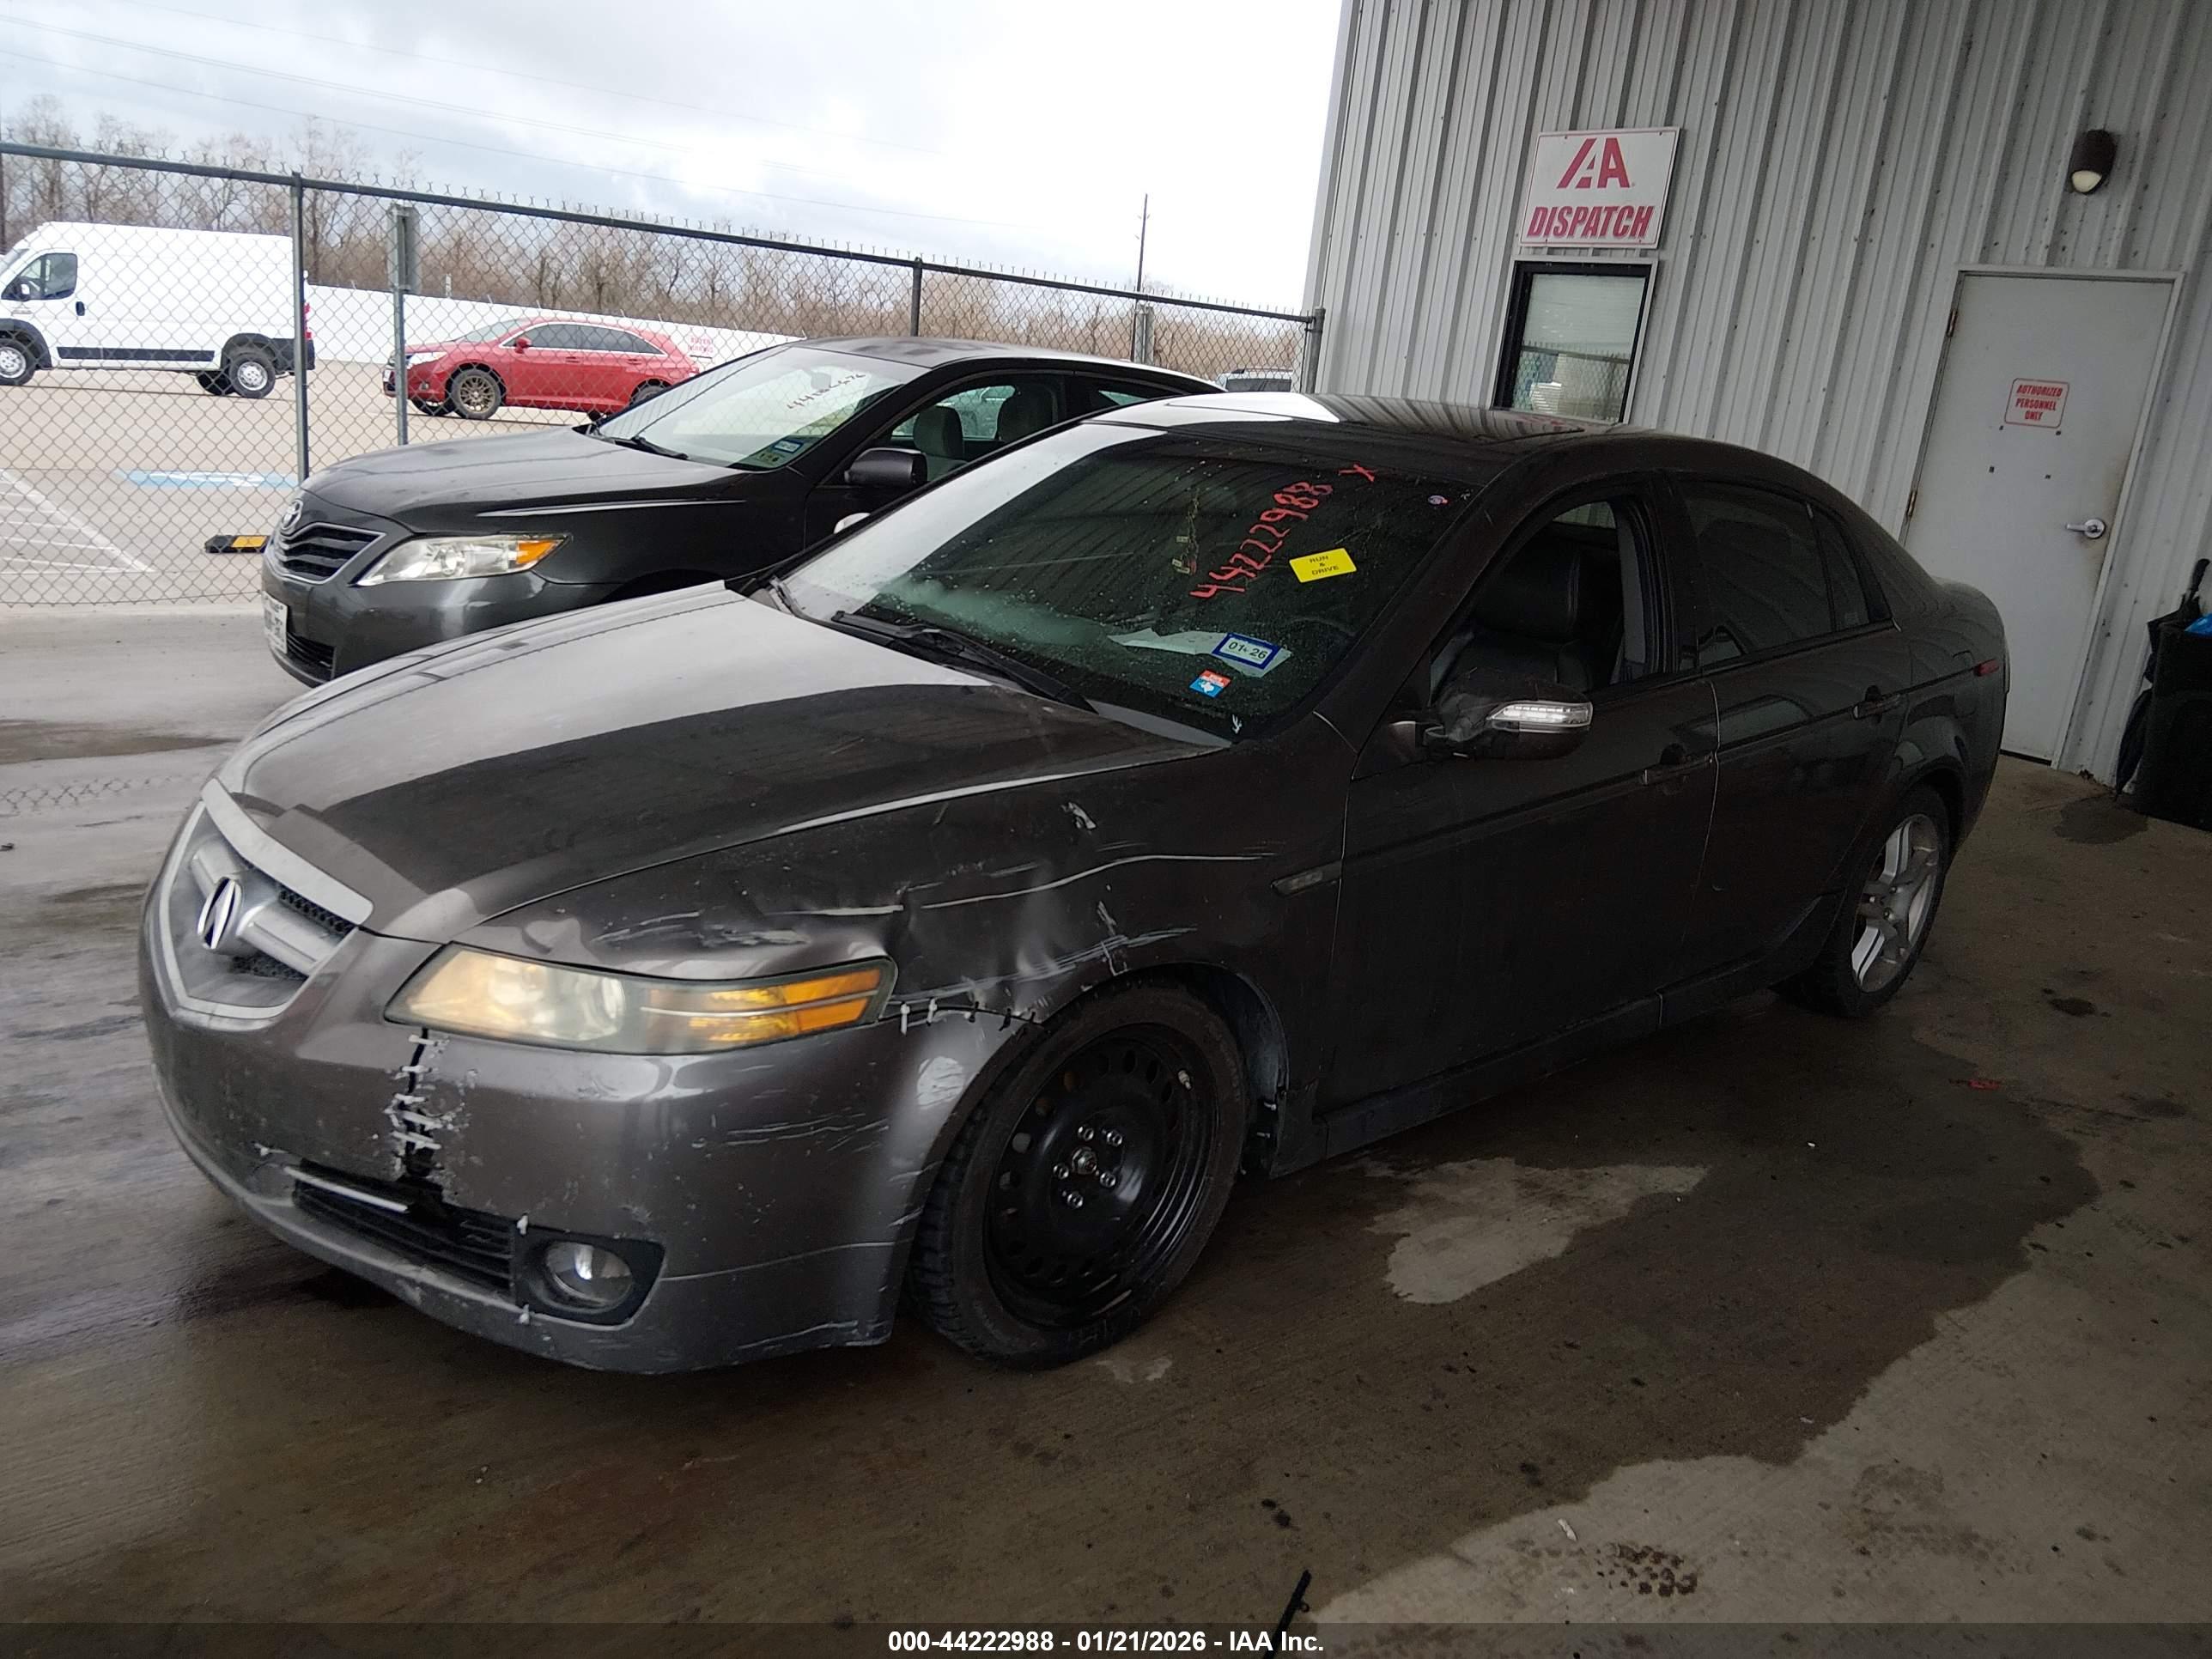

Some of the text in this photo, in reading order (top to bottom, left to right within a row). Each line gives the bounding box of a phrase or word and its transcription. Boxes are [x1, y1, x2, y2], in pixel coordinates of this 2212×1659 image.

[1527, 205, 1655, 239] DISPATCH
[2016, 384, 2063, 397] AUTHORIZED
[2015, 398, 2056, 410] PERSONNEL
[2025, 410, 2043, 421] ONLY
[1312, 566, 1340, 574] DRIVE
